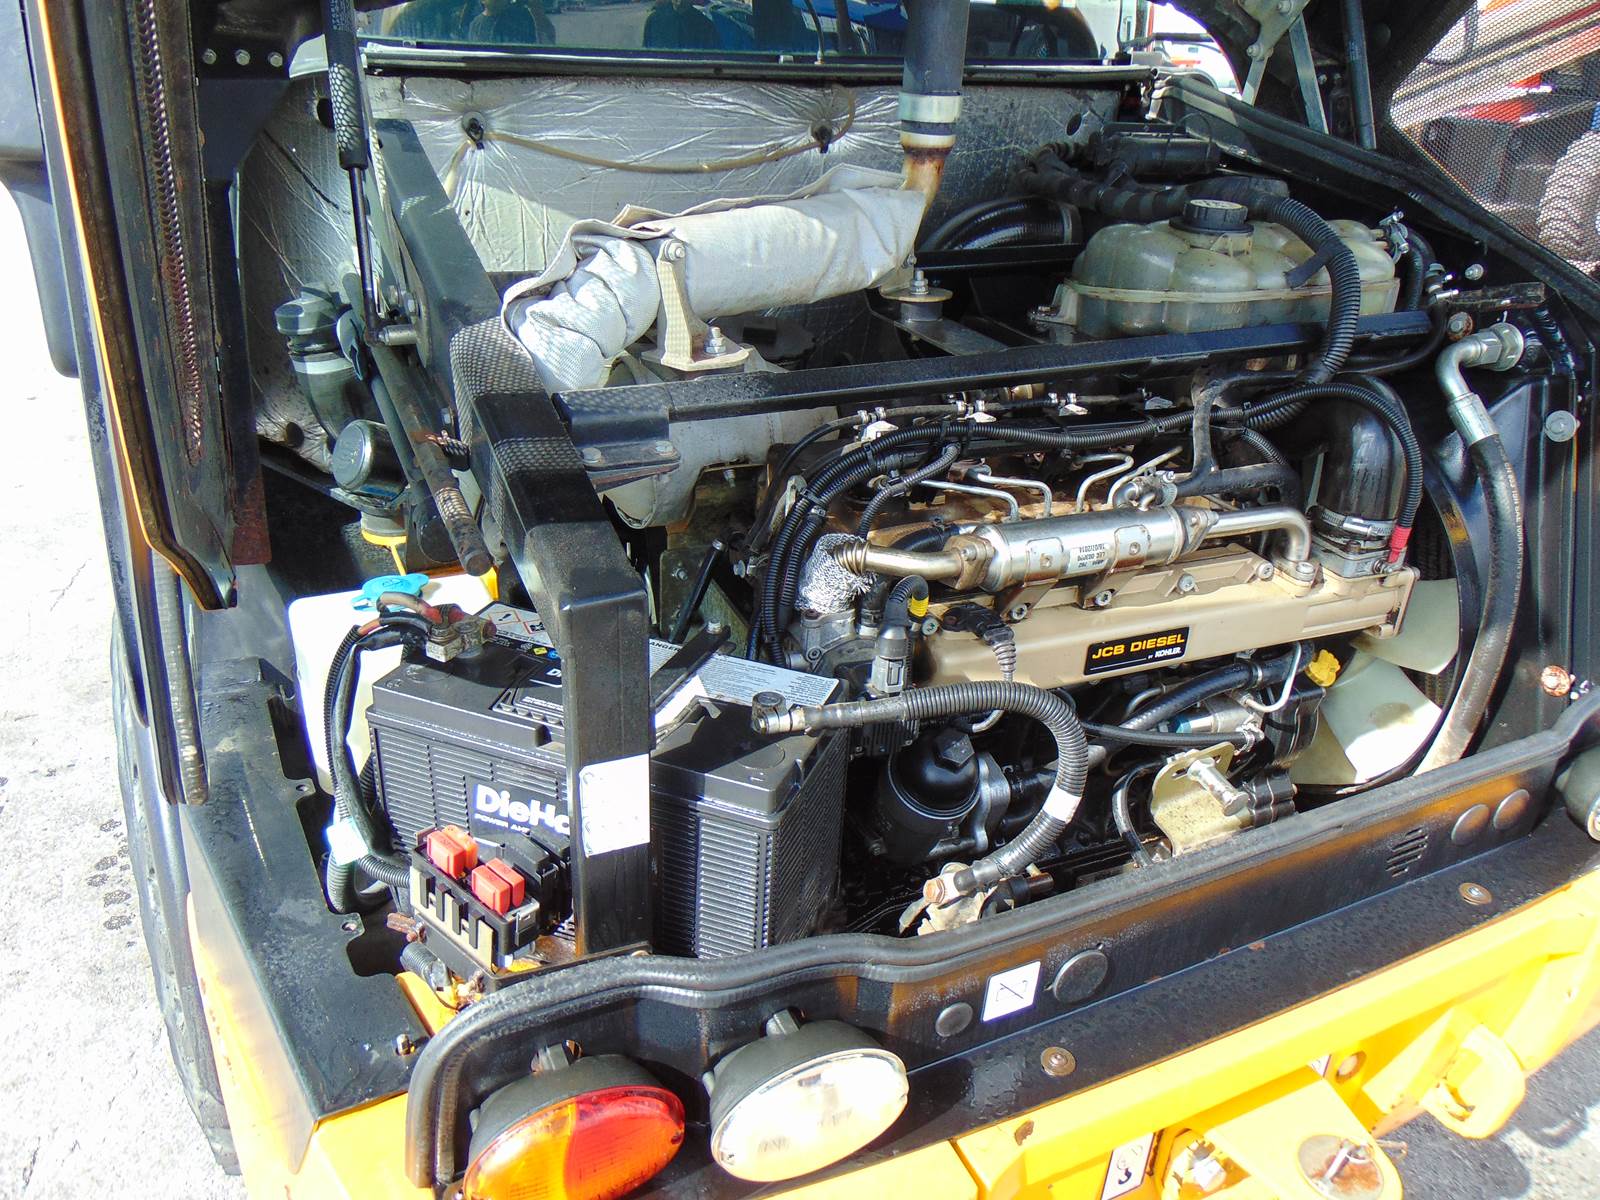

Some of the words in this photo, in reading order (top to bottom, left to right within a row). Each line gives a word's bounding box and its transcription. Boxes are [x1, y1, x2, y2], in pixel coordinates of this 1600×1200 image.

[1092, 644, 1125, 660] JCB
[1130, 634, 1185, 652] DIESEL
[1155, 647, 1181, 658] KOHLER
